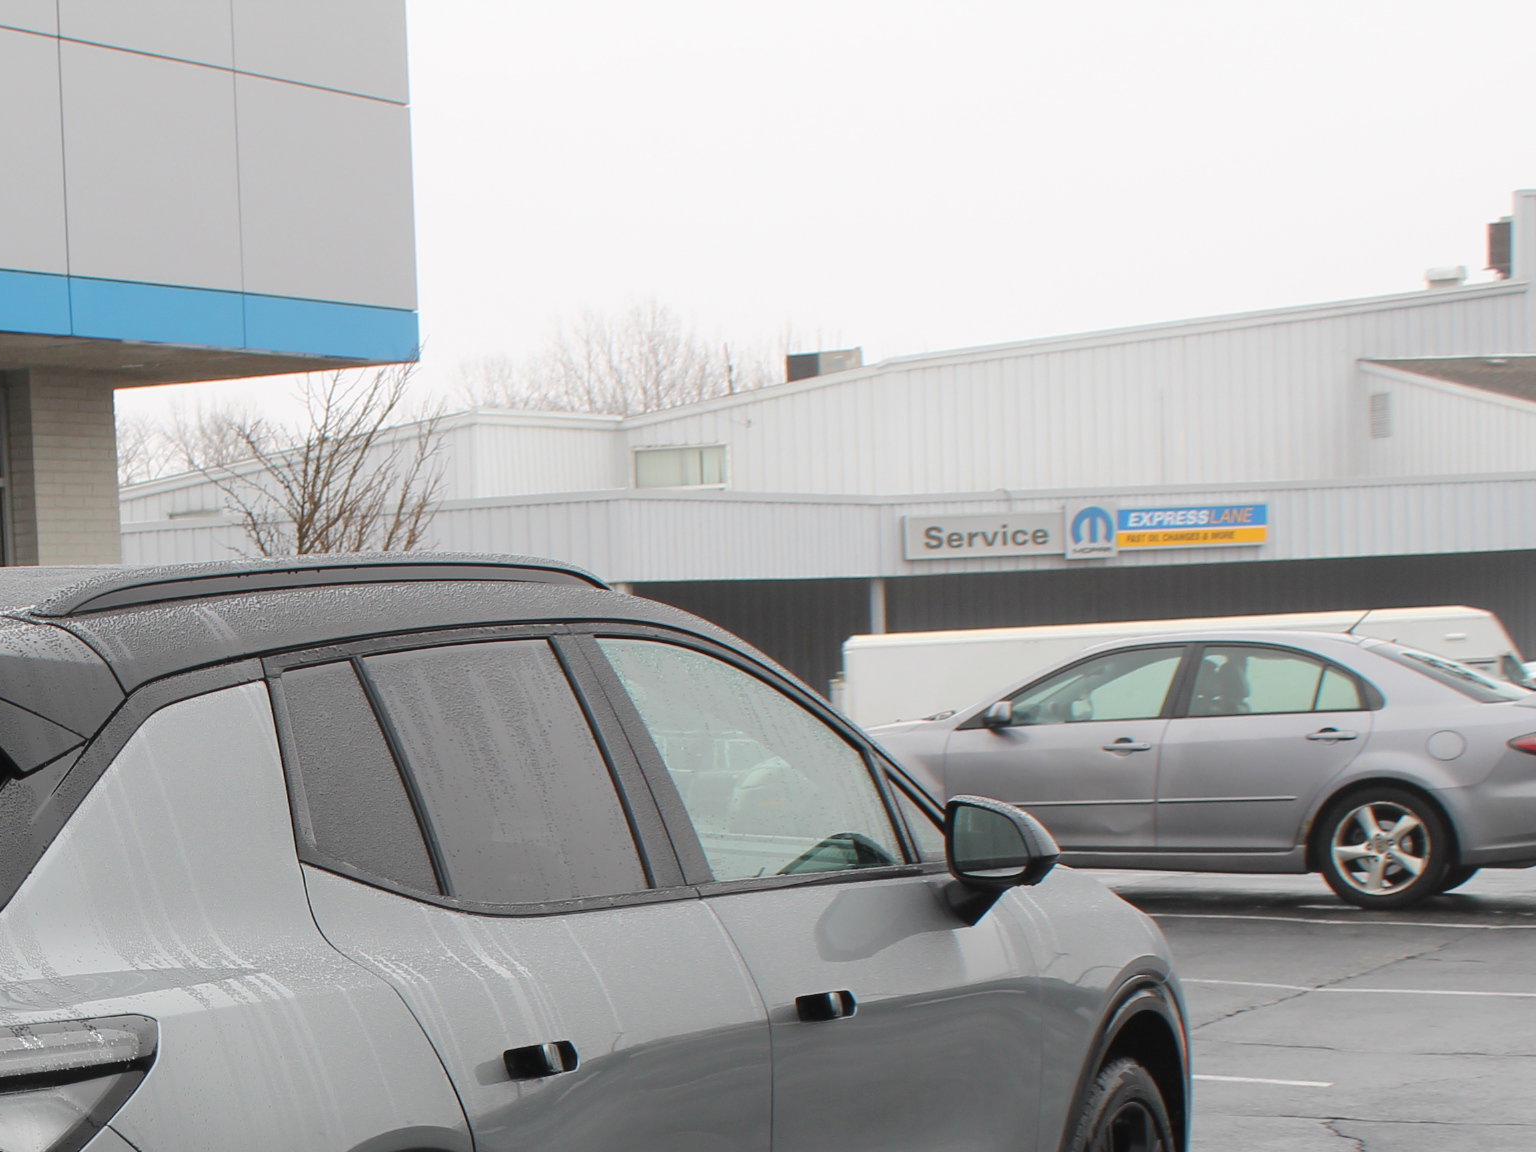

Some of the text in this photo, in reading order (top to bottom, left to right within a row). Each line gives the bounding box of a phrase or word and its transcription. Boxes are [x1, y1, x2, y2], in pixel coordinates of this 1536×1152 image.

[924, 524, 1050, 550] Service
[1126, 534, 1146, 544] FAST
[1163, 531, 1201, 542] CHANGES
[1211, 530, 1236, 540] MORE
